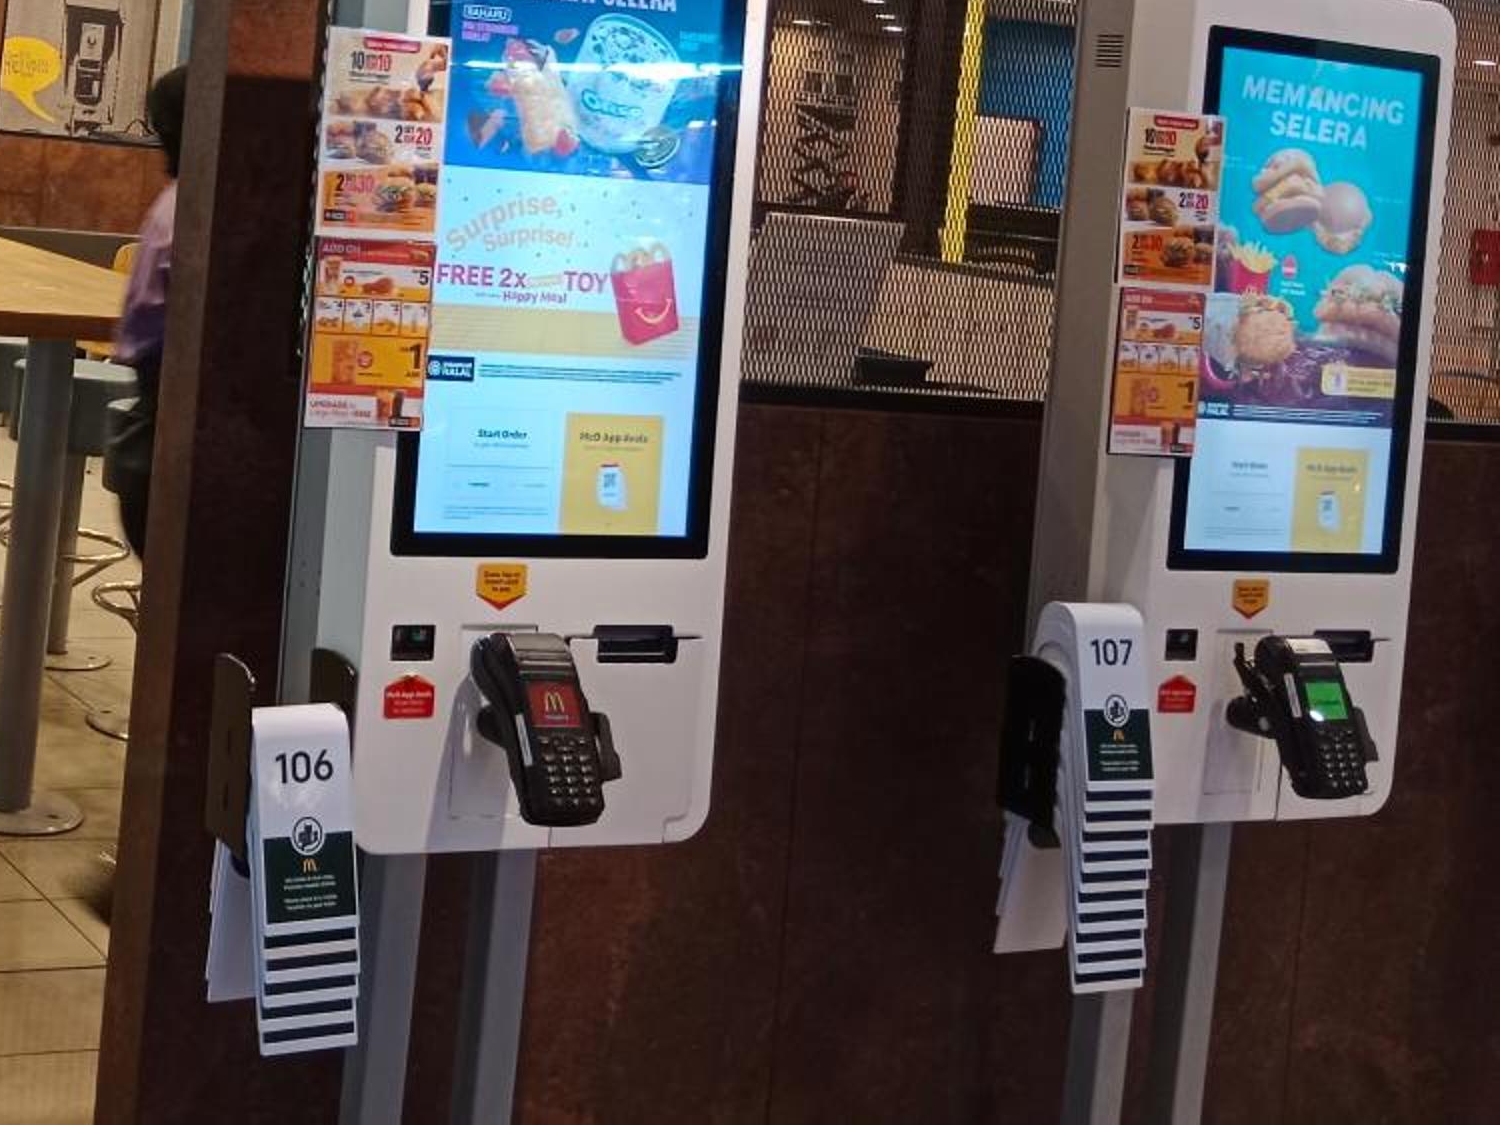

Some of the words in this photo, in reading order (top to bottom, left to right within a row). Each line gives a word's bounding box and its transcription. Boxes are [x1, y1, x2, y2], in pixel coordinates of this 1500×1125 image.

[1242, 74, 1406, 125] MEMANCING
[394, 125, 404, 144] 2
[416, 127, 434, 146] 20
[1269, 109, 1369, 150] SELERA
[446, 193, 564, 252] Surprise,
[482, 226, 574, 254] Surprise!
[436, 262, 495, 288] FREE
[499, 267, 528, 289] 2x
[563, 271, 610, 294] TOY
[1090, 637, 1134, 667] 107
[274, 748, 335, 785] 106
